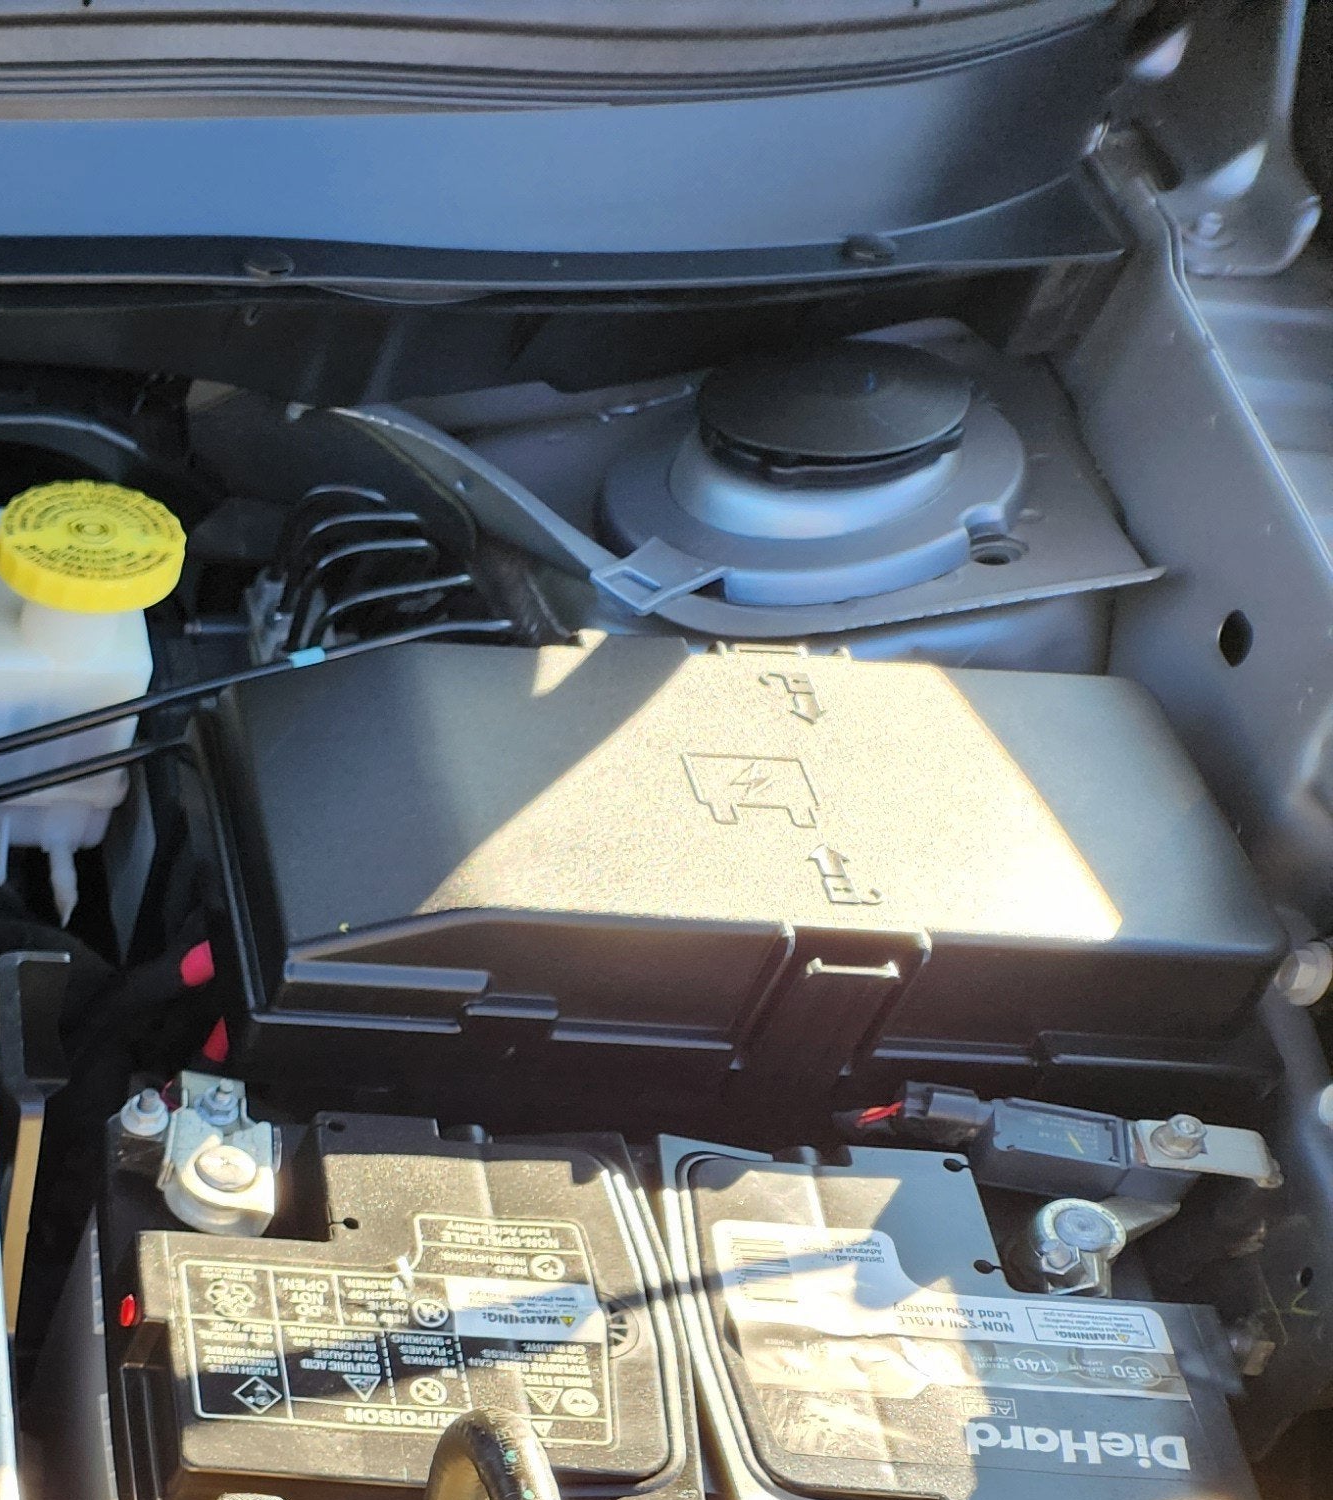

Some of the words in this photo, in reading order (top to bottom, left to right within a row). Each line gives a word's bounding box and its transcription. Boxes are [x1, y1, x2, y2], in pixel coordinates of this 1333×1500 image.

[440, 1231, 560, 1249] NON-SPILLABLE
[494, 1265, 528, 1275] READ
[289, 1292, 324, 1306] NOT
[295, 1304, 322, 1317] DO
[978, 1308, 1010, 1320] Lead
[482, 1312, 560, 1325] WARNING:
[249, 1333, 273, 1343] GET
[293, 1337, 311, 1347] OR
[1055, 1331, 1118, 1341] WARNING:
[246, 1349, 276, 1358] WITH
[312, 1349, 352, 1361] CAUSE
[353, 1352, 379, 1362] CAN
[300, 1358, 327, 1370] ACID
[328, 1361, 381, 1374] SULFURIC
[468, 1357, 494, 1368] CAN
[1013, 1357, 1052, 1372] 140
[240, 1366, 278, 1377] FLUSH
[1112, 1365, 1154, 1380] 850
[965, 1421, 1191, 1470] DieHard
